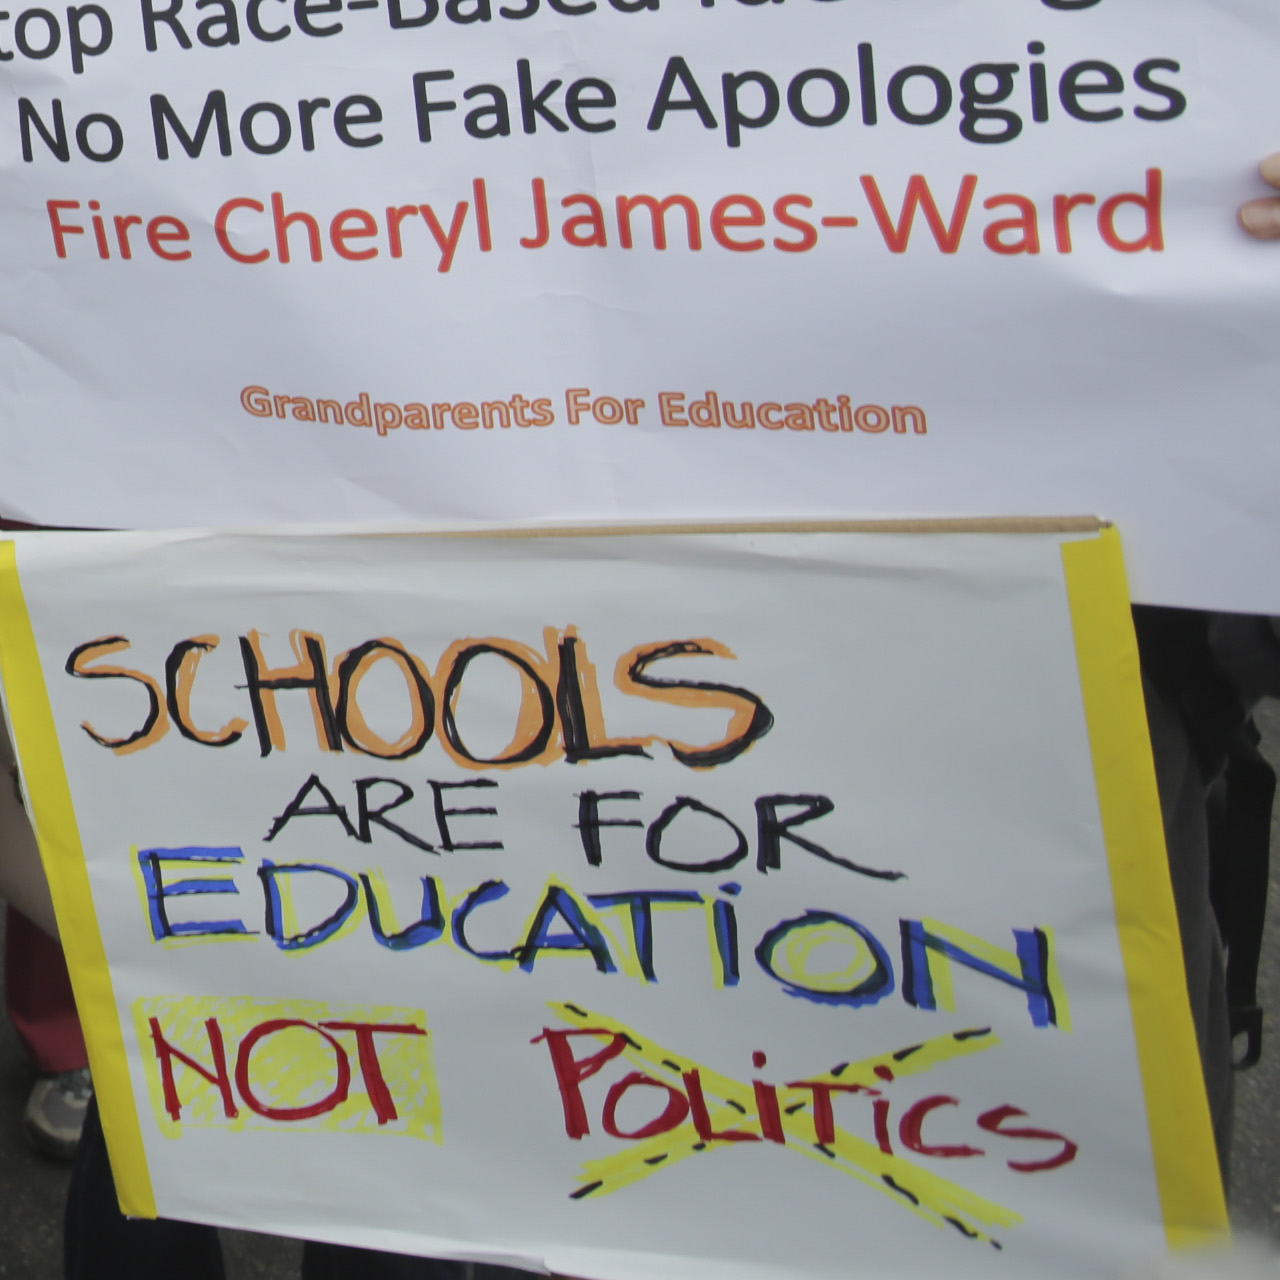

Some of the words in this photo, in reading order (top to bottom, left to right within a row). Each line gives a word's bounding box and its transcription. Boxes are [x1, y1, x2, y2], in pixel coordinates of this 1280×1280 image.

[17, 97, 124, 164] No
[150, 89, 384, 160] More
[412, 59, 617, 143] Fake
[646, 40, 1187, 148] Apologies
[45, 198, 192, 263] Fire
[214, 177, 492, 273] Cheryl
[519, 167, 1166, 257] James-Ward
[239, 385, 555, 436] Grandparents
[565, 387, 645, 428] For
[659, 391, 927, 435] Education
[63, 625, 776, 770] SCHOOLS
[264, 772, 506, 855] ARE
[573, 788, 908, 884] FOR
[147, 1014, 427, 1126] NOT
